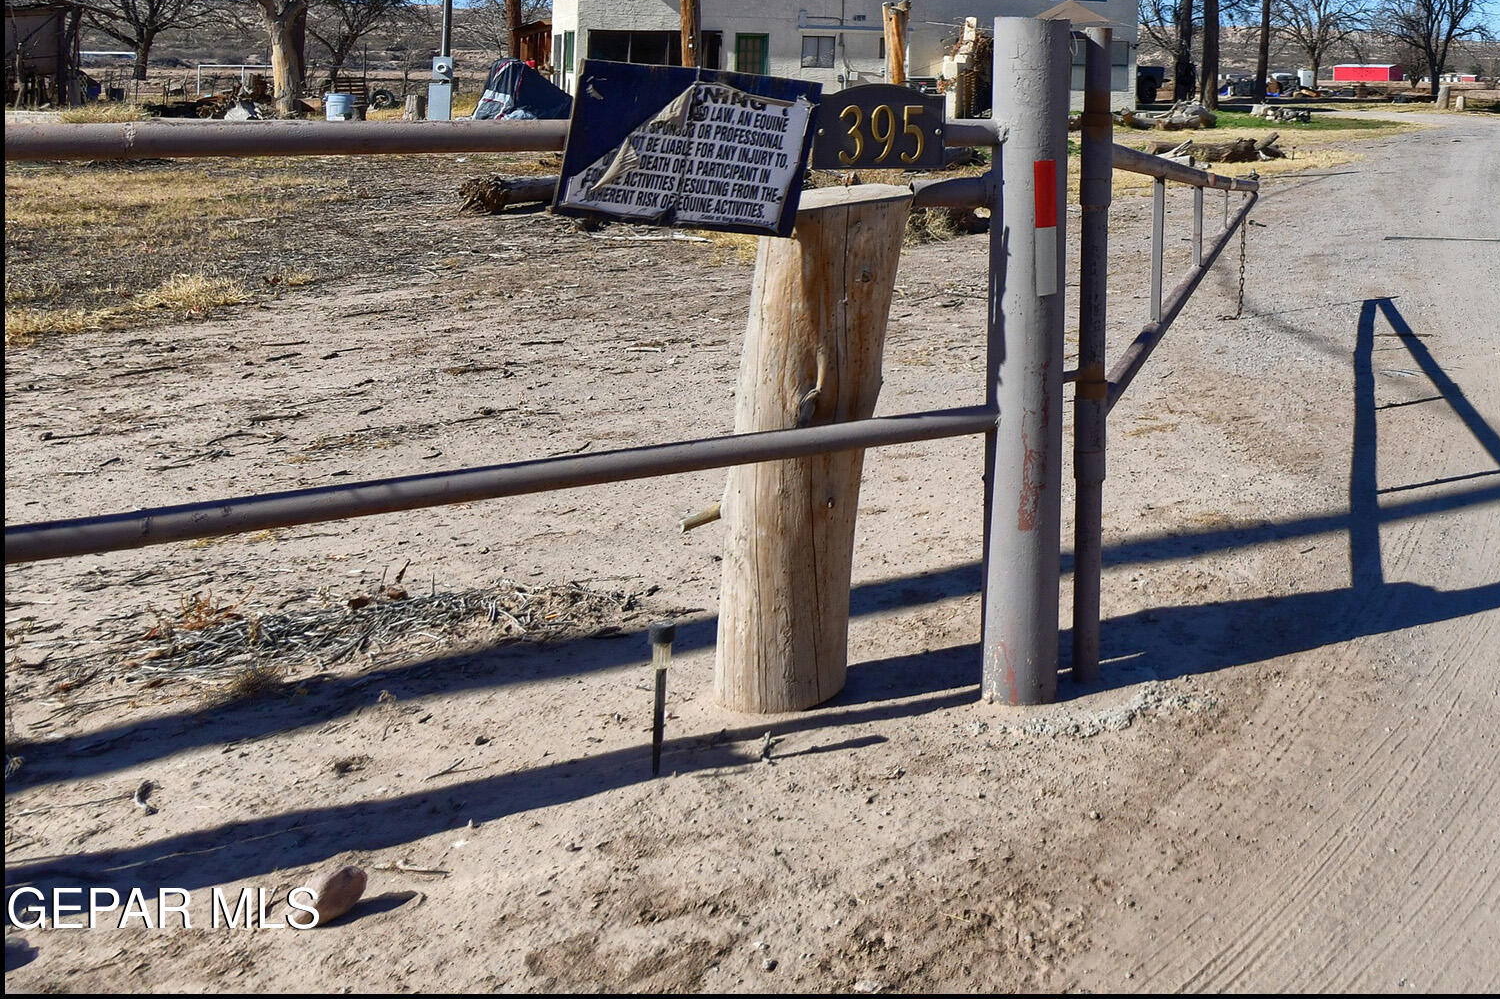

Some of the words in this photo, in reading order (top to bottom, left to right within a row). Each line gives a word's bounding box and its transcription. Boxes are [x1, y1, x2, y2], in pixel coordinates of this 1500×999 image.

[698, 123, 712, 140] OR
[714, 125, 784, 150] PROFESSIONAL
[737, 110, 753, 127] AN
[753, 113, 790, 133] EQUINE
[838, 104, 924, 165] 395
[646, 136, 660, 152] BE
[660, 138, 694, 157] LIABLE
[695, 142, 716, 158] FOR
[715, 144, 738, 161] ANY
[737, 147, 775, 166] INJURY
[775, 152, 789, 170] TO,
[639, 154, 671, 173] DEATH
[686, 160, 694, 175] A
[696, 160, 759, 182] PARTICIPANT
[758, 168, 771, 184] IN
[623, 171, 675, 191] ACTIVITIES
[676, 177, 730, 197] RESULTING
[730, 183, 760, 200] FROM
[761, 187, 778, 202] THE
[635, 191, 660, 207] RISK
[677, 196, 714, 214] EQUINE
[713, 200, 765, 219] ACTIVITIES.
